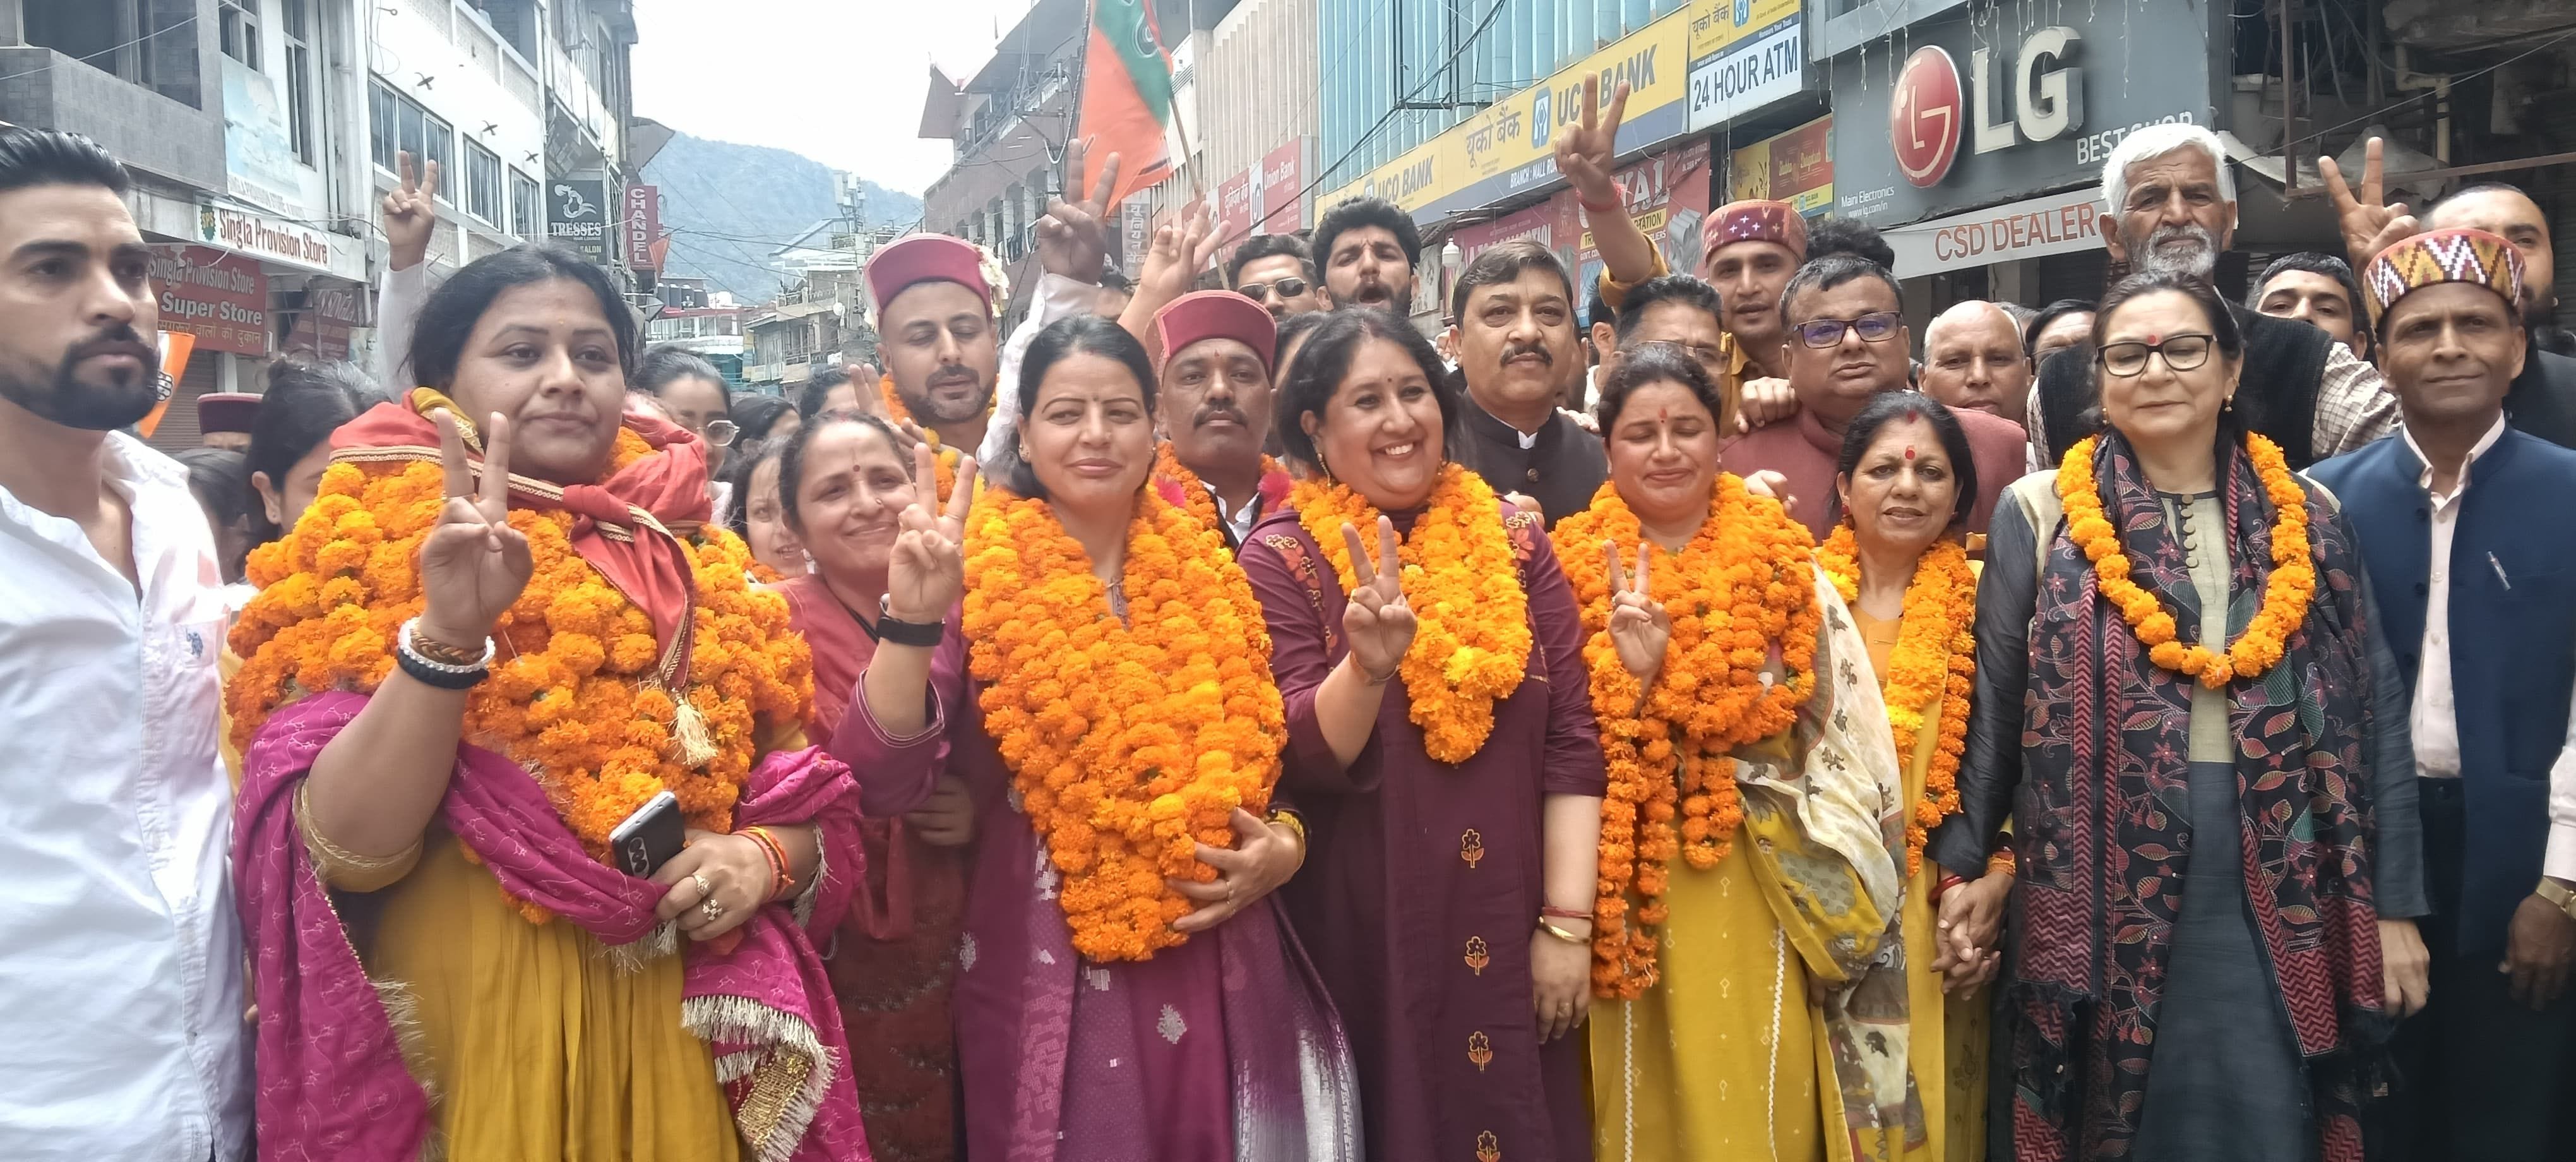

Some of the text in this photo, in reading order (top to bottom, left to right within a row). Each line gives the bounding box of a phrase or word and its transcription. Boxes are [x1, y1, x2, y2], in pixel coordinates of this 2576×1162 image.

[1692, 3, 1729, 40] यूको बैंक
[1558, 44, 1657, 127] UC BANK
[1694, 35, 1798, 112] 24 HOUR ATM
[1973, 27, 2082, 155] LG
[1466, 106, 1522, 169] यूको बैंक
[1264, 157, 1295, 191] Union Bank
[1402, 155, 1434, 198] BANK
[1510, 167, 1529, 189] BRANCH
[1532, 160, 1546, 181] MALL
[1547, 157, 1558, 176] ROA
[1859, 185, 1895, 203] Electronics
[551, 222, 602, 236] TRESSES
[630, 188, 647, 262] CHANDEL
[1848, 200, 1888, 218] www.lg.com/in
[219, 208, 328, 265] Singla Provision Store
[1935, 202, 2097, 261] CSD DEALER
[148, 253, 255, 295] Singla Provision Store
[161, 292, 263, 326] Super Store
[222, 324, 233, 340] की
[237, 329, 261, 347] दुकान
